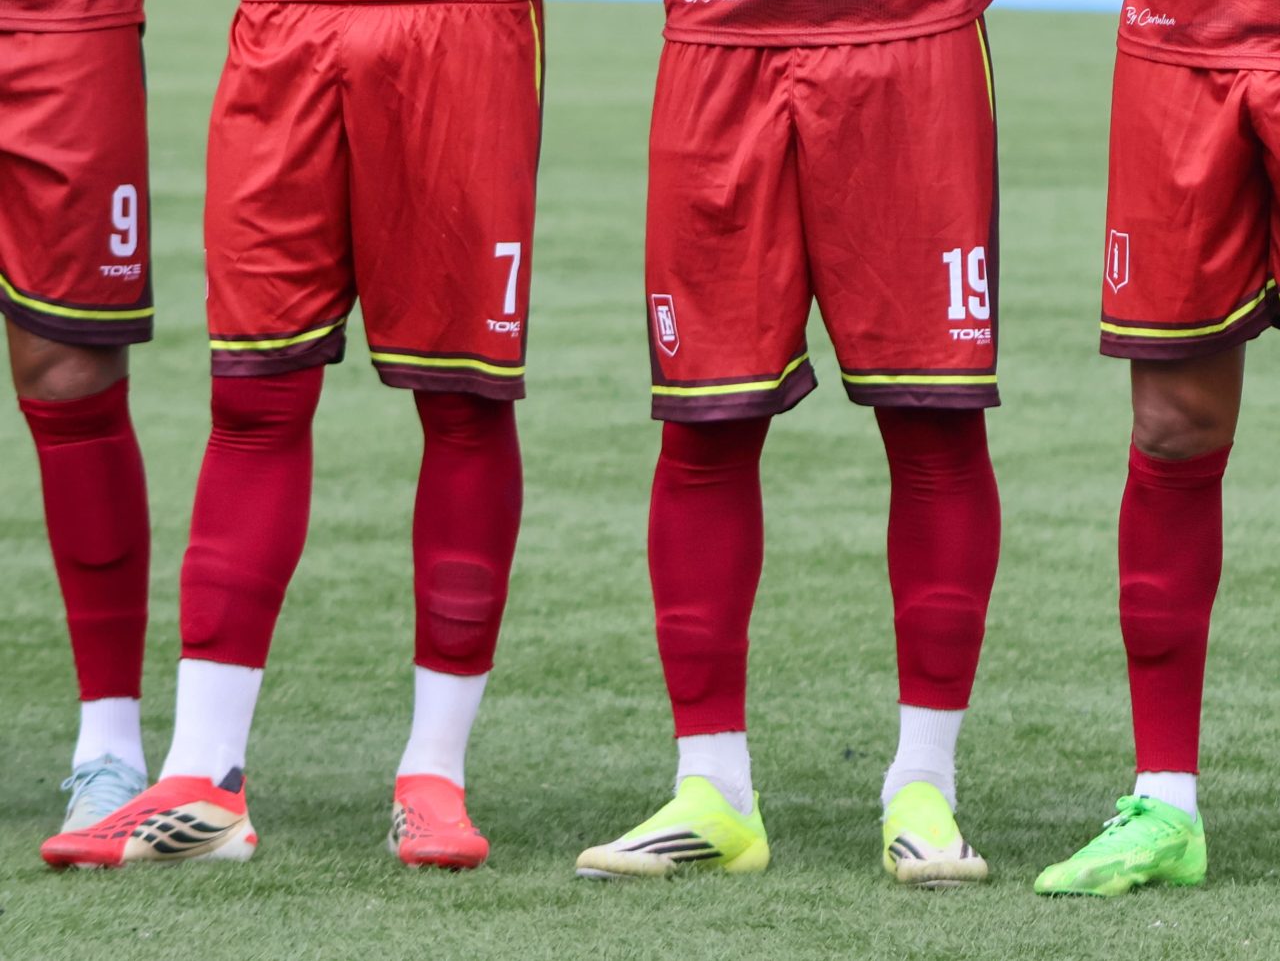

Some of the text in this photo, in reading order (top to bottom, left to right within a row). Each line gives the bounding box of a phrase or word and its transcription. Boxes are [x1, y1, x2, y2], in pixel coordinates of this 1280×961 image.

[109, 183, 138, 257] 9
[100, 263, 142, 277] TOKE
[494, 242, 522, 315] 7
[942, 246, 992, 320] 19
[949, 328, 992, 341] TOKE
